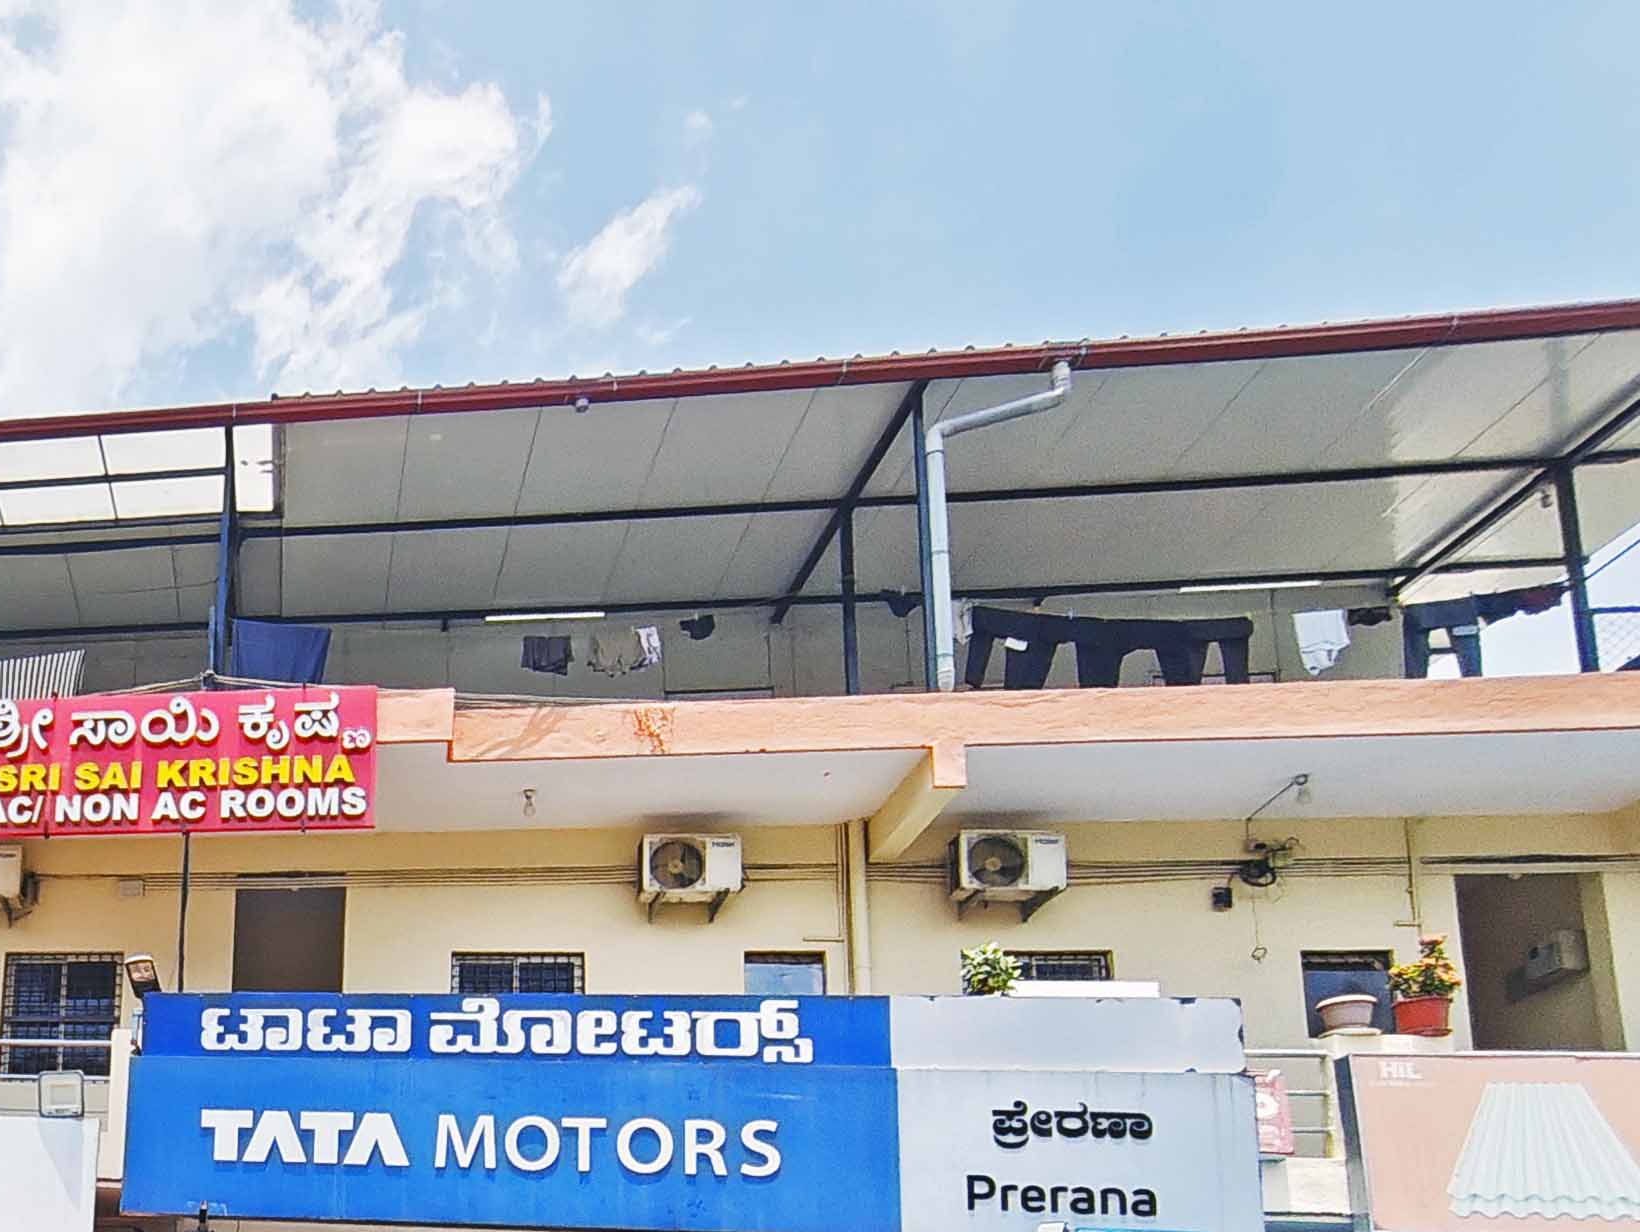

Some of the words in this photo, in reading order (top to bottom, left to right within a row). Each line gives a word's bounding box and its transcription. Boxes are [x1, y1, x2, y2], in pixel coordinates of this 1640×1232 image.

[69, 697, 220, 747] ಸಾಯಿ
[237, 692, 372, 753] ಕೃಷ್ಣ
[74, 760, 142, 794] SAI
[157, 754, 356, 790] KRISHNA
[54, 793, 140, 823] NON
[151, 791, 207, 821] AC
[220, 786, 367, 819] ROOMS
[201, 1007, 412, 1055] ಟಾಟಾ
[429, 998, 814, 1063] ಮೋಟರ್ಸ್
[200, 1108, 410, 1167] TATA
[433, 1113, 783, 1178] MOTORS
[992, 1100, 1153, 1149] ಪ್ರೇರಣಾ
[965, 1174, 1159, 1218] Prerana
